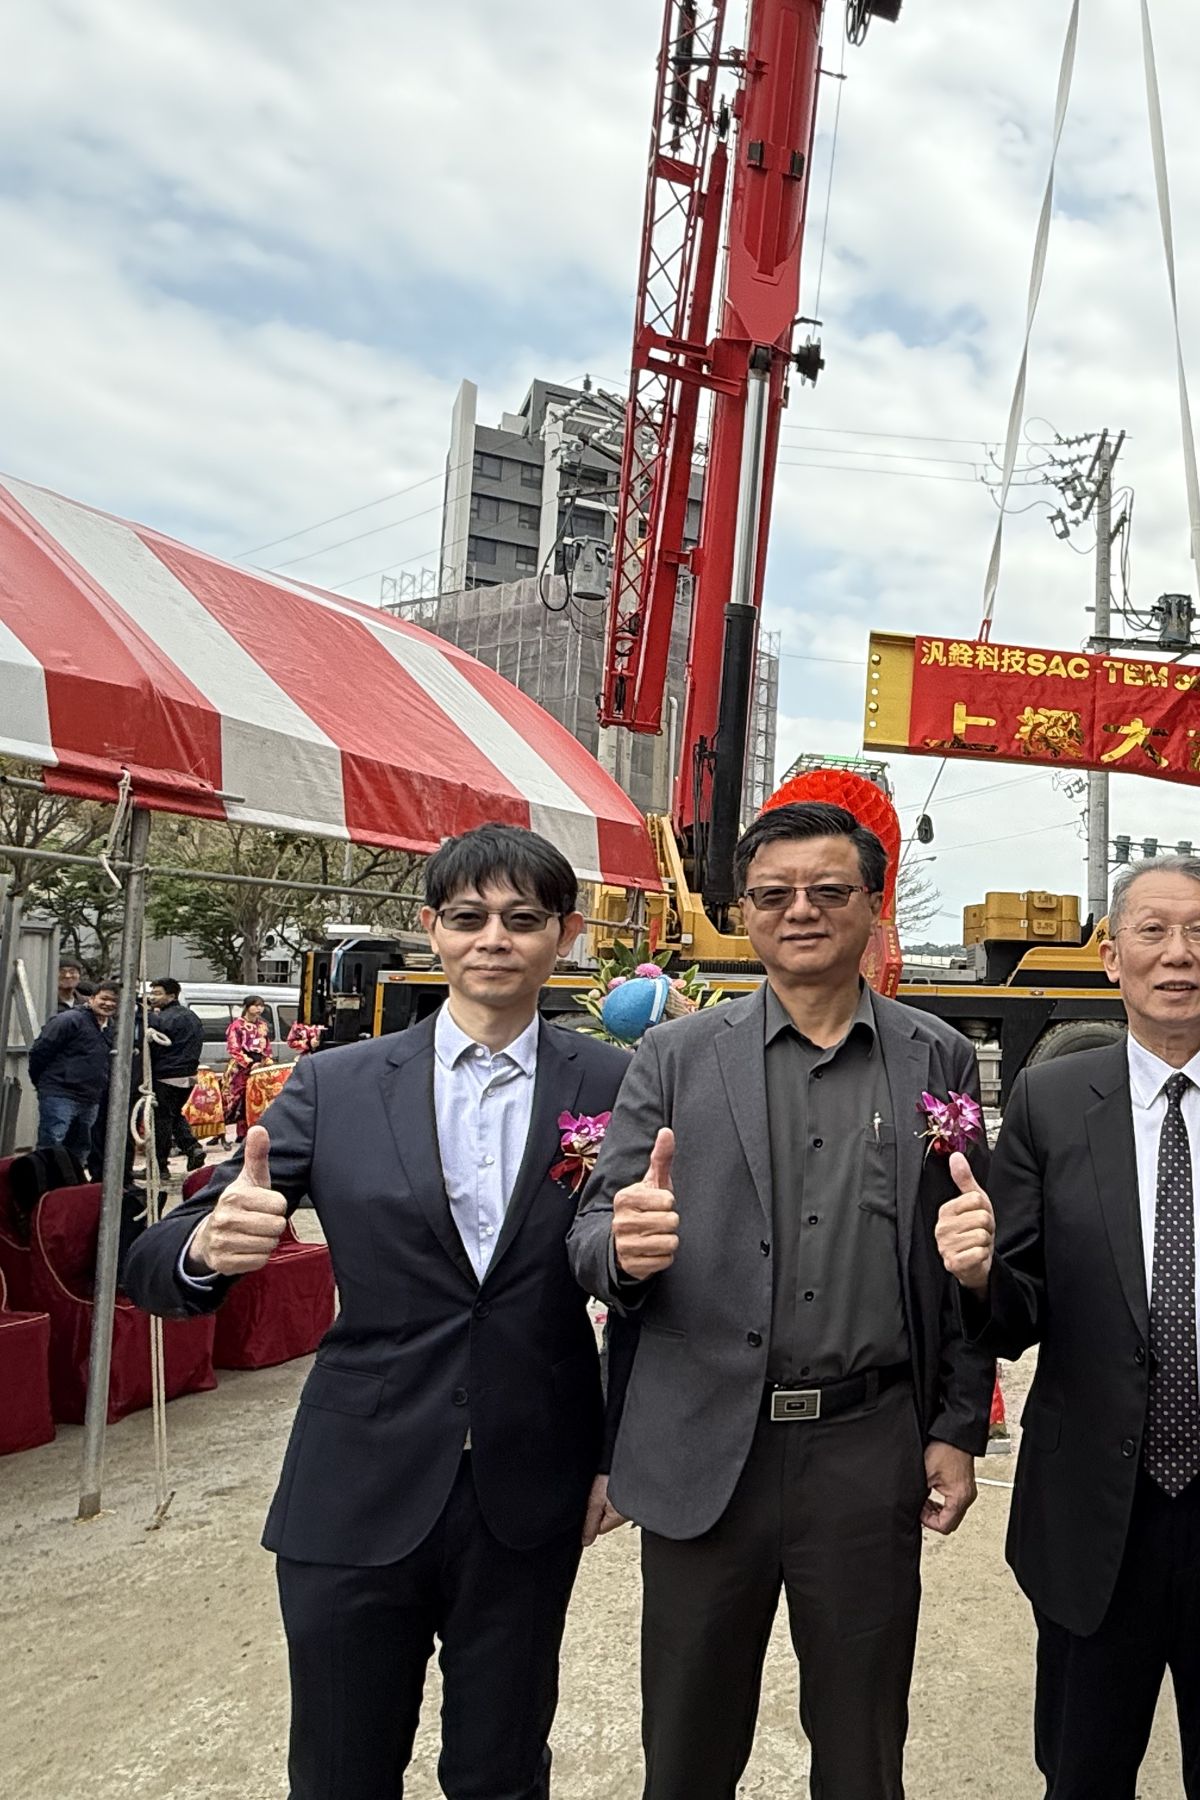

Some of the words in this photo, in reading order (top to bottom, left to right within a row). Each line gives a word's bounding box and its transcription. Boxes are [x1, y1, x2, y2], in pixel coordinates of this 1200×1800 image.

[921, 640, 1090, 680] 汎銓科技SAC
[1102, 660, 1169, 688] TEM
